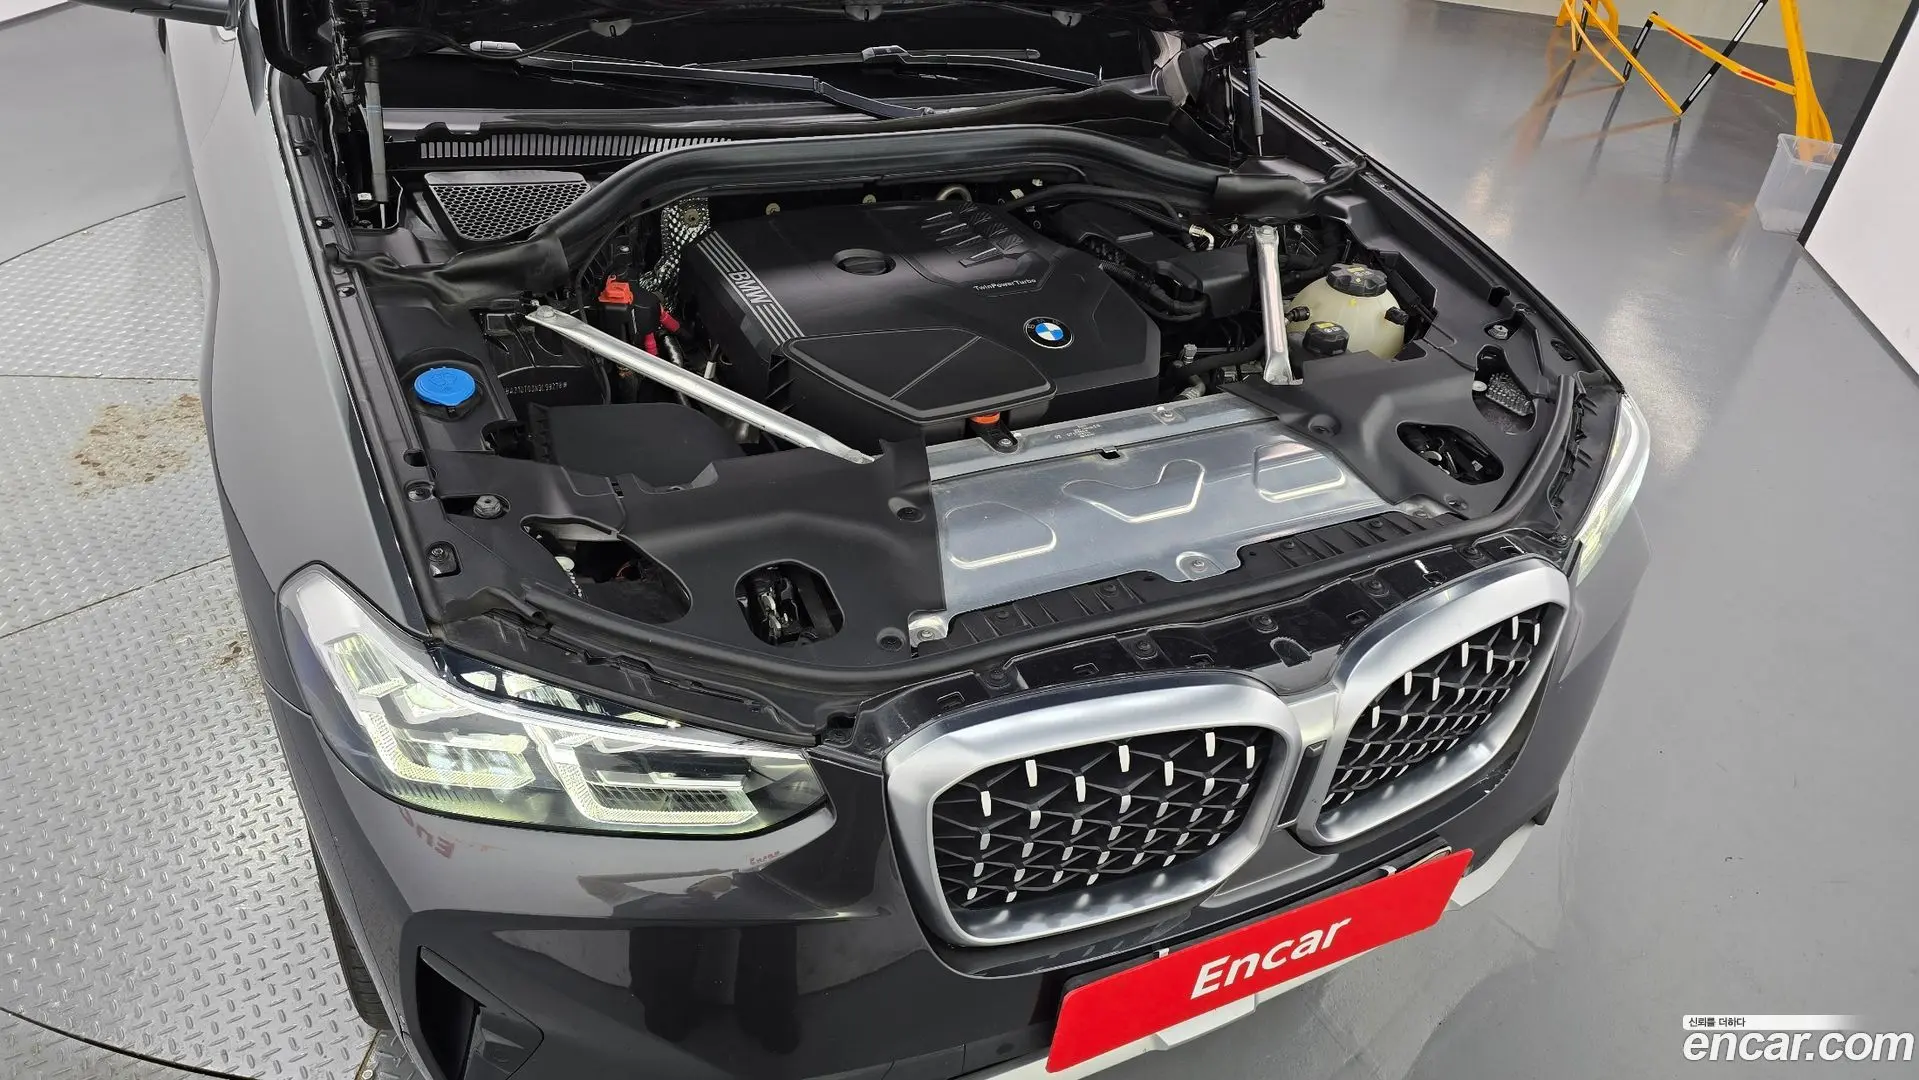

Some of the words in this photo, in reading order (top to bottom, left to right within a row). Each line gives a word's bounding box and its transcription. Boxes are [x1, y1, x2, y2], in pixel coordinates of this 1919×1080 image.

[728, 270, 773, 304] BMW
[972, 278, 1037, 291] TwinPowerTurbo
[1190, 917, 1352, 1000] Encar
